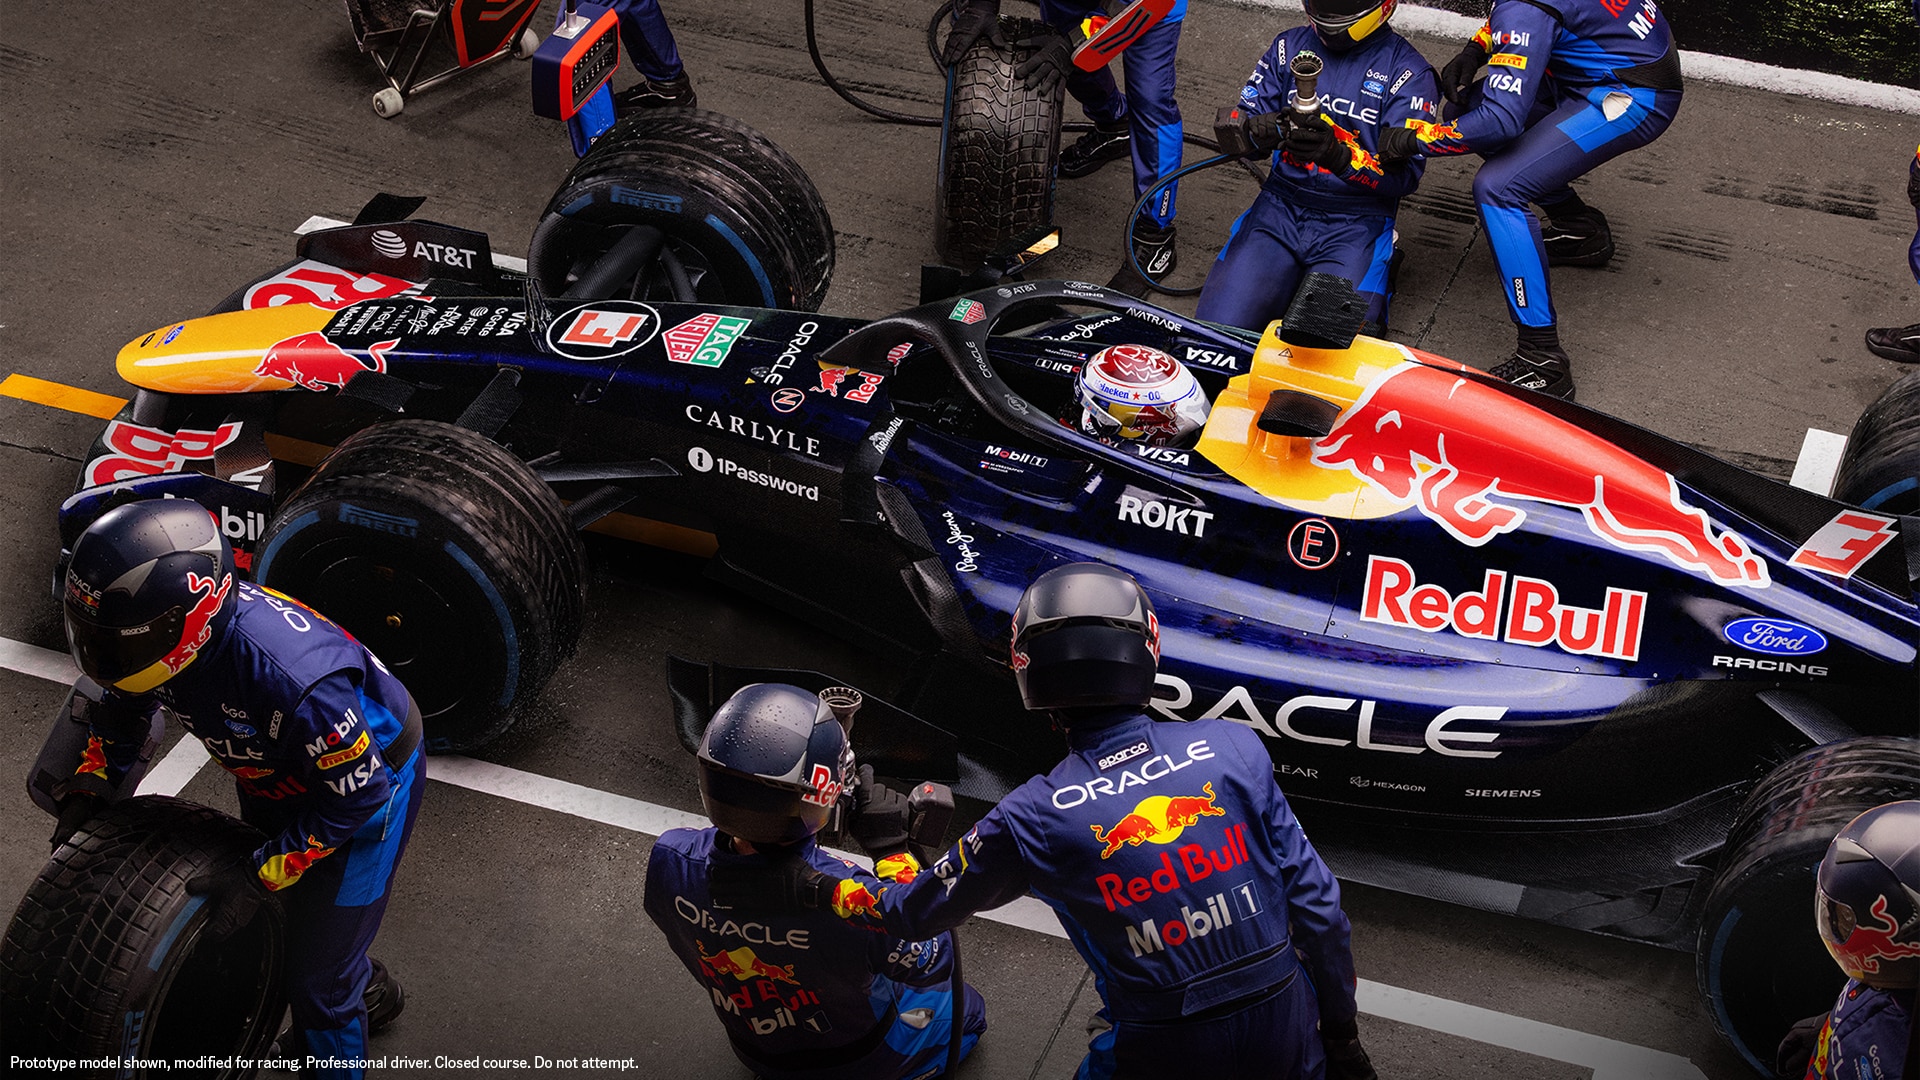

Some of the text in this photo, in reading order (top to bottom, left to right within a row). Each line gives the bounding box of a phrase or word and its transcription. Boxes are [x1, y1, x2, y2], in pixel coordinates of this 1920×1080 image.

[1492, 30, 1530, 47] Mobil
[1390, 69, 1413, 95] sparco
[610, 185, 683, 214] PIRELLI
[413, 241, 477, 270] AT&T
[1012, 283, 1037, 295] AT&T
[1063, 289, 1104, 298] RACING
[495, 311, 527, 336] VISA
[952, 300, 971, 318] TAG
[1125, 307, 1182, 333] AVATRADE
[666, 313, 720, 361] HEUER
[697, 318, 750, 364] TAG
[763, 321, 818, 386] ORACLE
[965, 341, 993, 379] ORACLE
[1186, 347, 1239, 371] VISA
[845, 372, 883, 402] Red
[685, 404, 821, 457] CARLYLE
[984, 445, 1030, 463] Mobil
[1135, 443, 1190, 467] VISA
[717, 457, 820, 502] 1Password
[214, 506, 265, 541] bil
[338, 502, 418, 538] PIRELLI
[1117, 494, 1214, 538] ROKT
[1300, 525, 1326, 563] E
[1364, 558, 1644, 658] Red Bull
[120, 624, 150, 636] sparco
[1743, 622, 1808, 651] Ford
[1712, 655, 1829, 676] RACING
[268, 710, 284, 740] sparco
[1150, 672, 1510, 758] RACLE
[305, 707, 359, 758] Mobil
[1098, 742, 1149, 770] sparco
[1272, 763, 1319, 779] LEAR
[324, 754, 381, 797] VISA
[1052, 739, 1216, 810] ORACLE
[1373, 781, 1426, 793] HEXAGON
[1465, 788, 1542, 798] SIEMENS
[1095, 823, 1250, 913] Red Bull
[675, 895, 811, 950] ORACLE
[1125, 893, 1233, 958] Mobil
[712, 986, 797, 1036] Mbil
